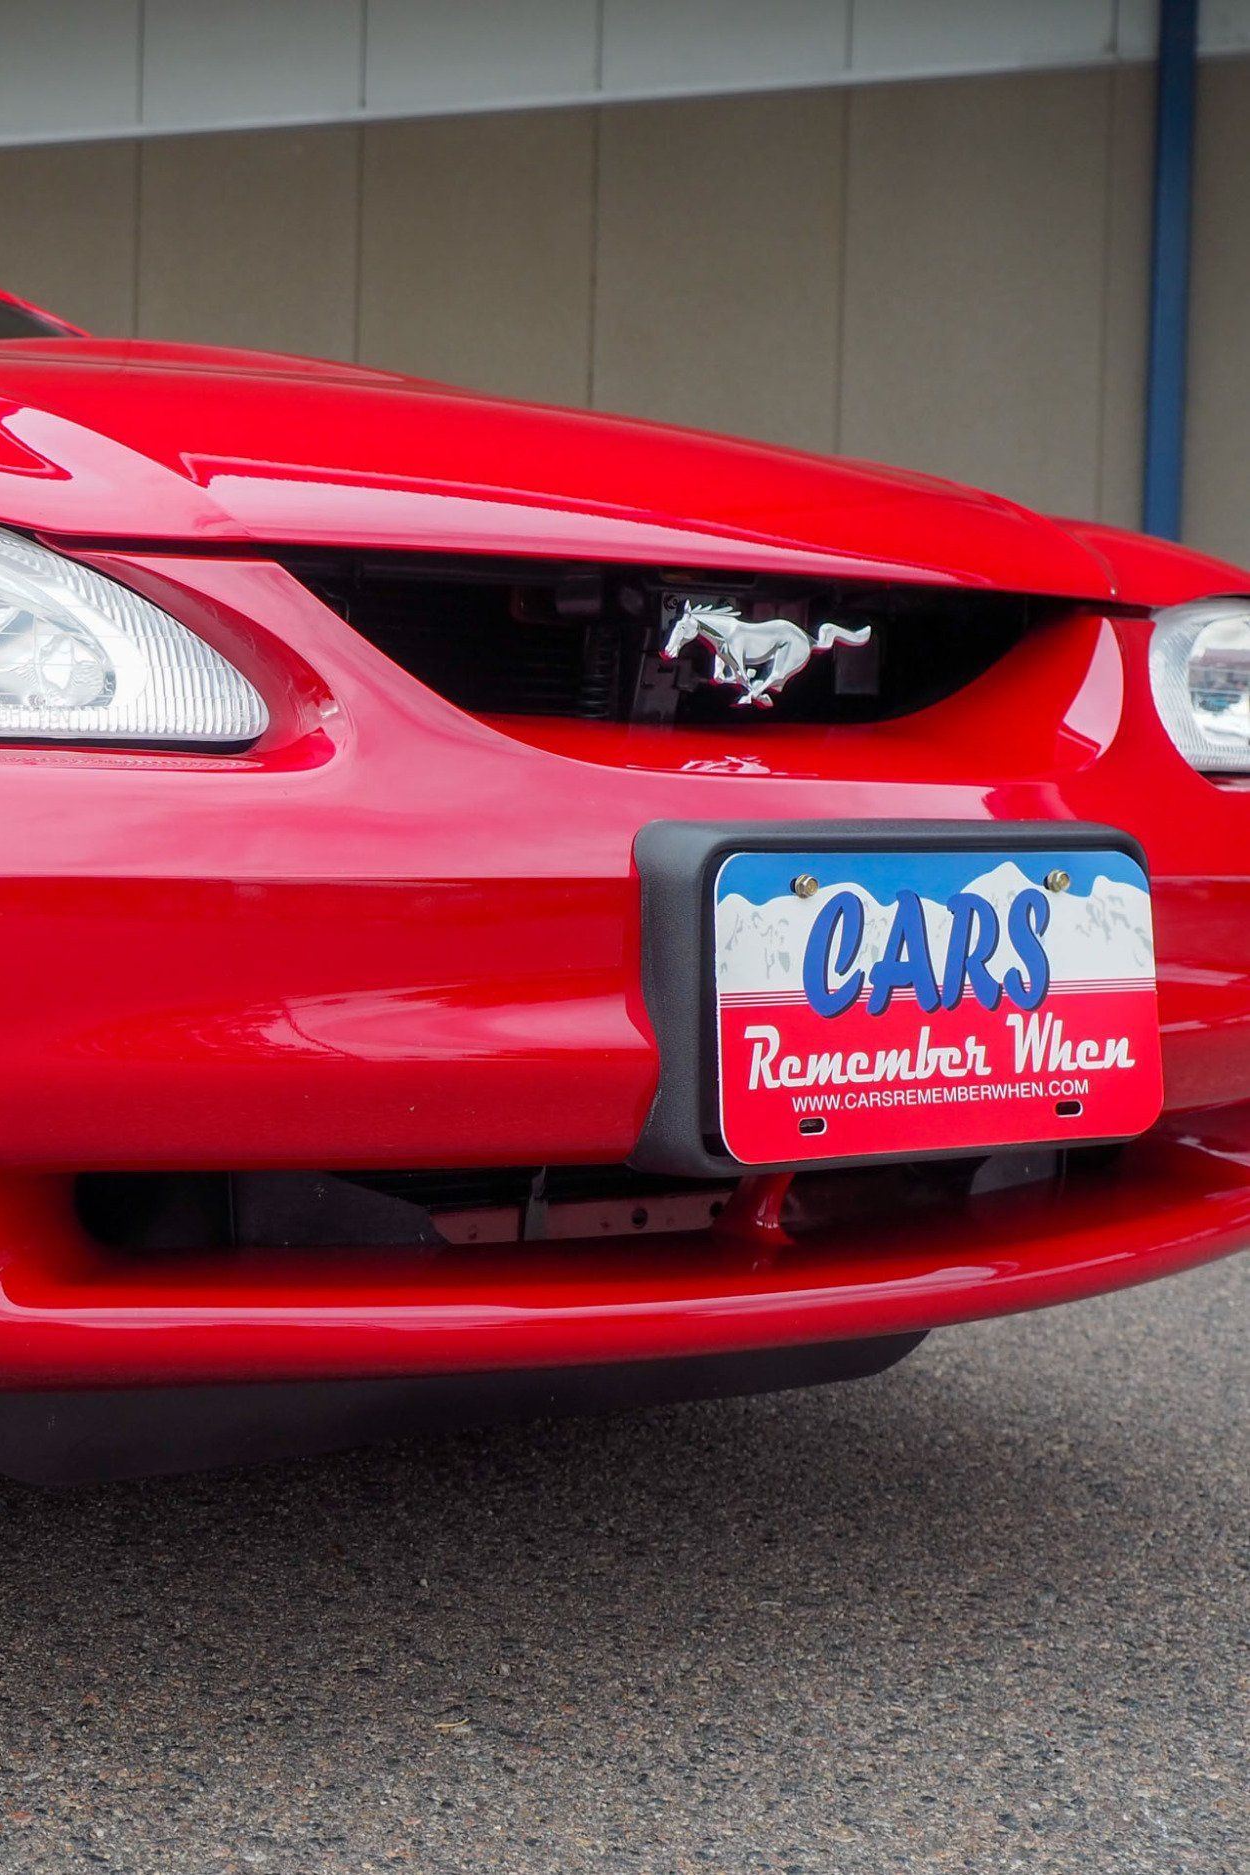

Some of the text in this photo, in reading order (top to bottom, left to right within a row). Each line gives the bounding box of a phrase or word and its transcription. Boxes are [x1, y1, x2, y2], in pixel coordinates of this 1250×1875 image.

[803, 889, 1050, 1018] CARS
[744, 1012, 1135, 1090] Remember When
[792, 1079, 1089, 1112] WWW.CARSREMEMBERWHEN.COM
